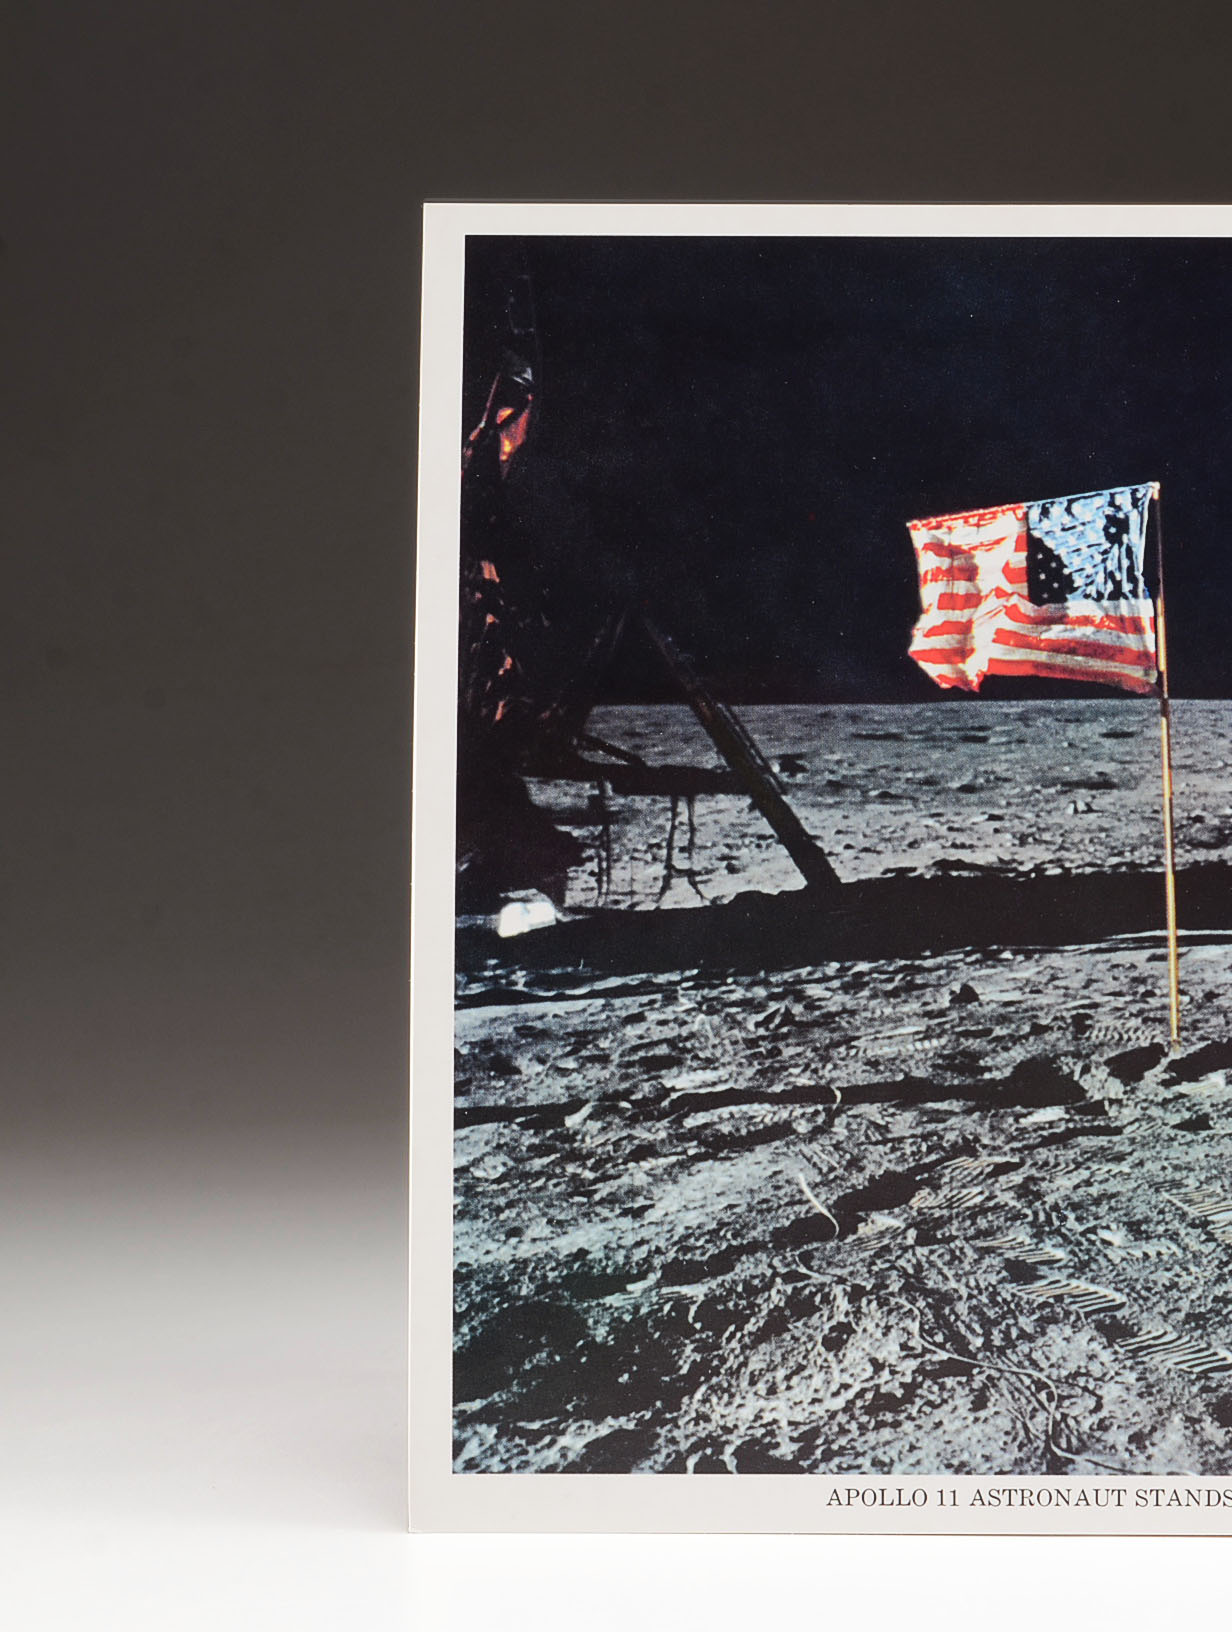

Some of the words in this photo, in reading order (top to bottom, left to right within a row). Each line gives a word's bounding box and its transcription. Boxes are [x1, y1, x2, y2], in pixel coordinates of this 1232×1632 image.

[826, 1488, 928, 1507] APOLLO
[936, 1488, 960, 1507] 11
[968, 1488, 1128, 1508] ASTRONAUT
